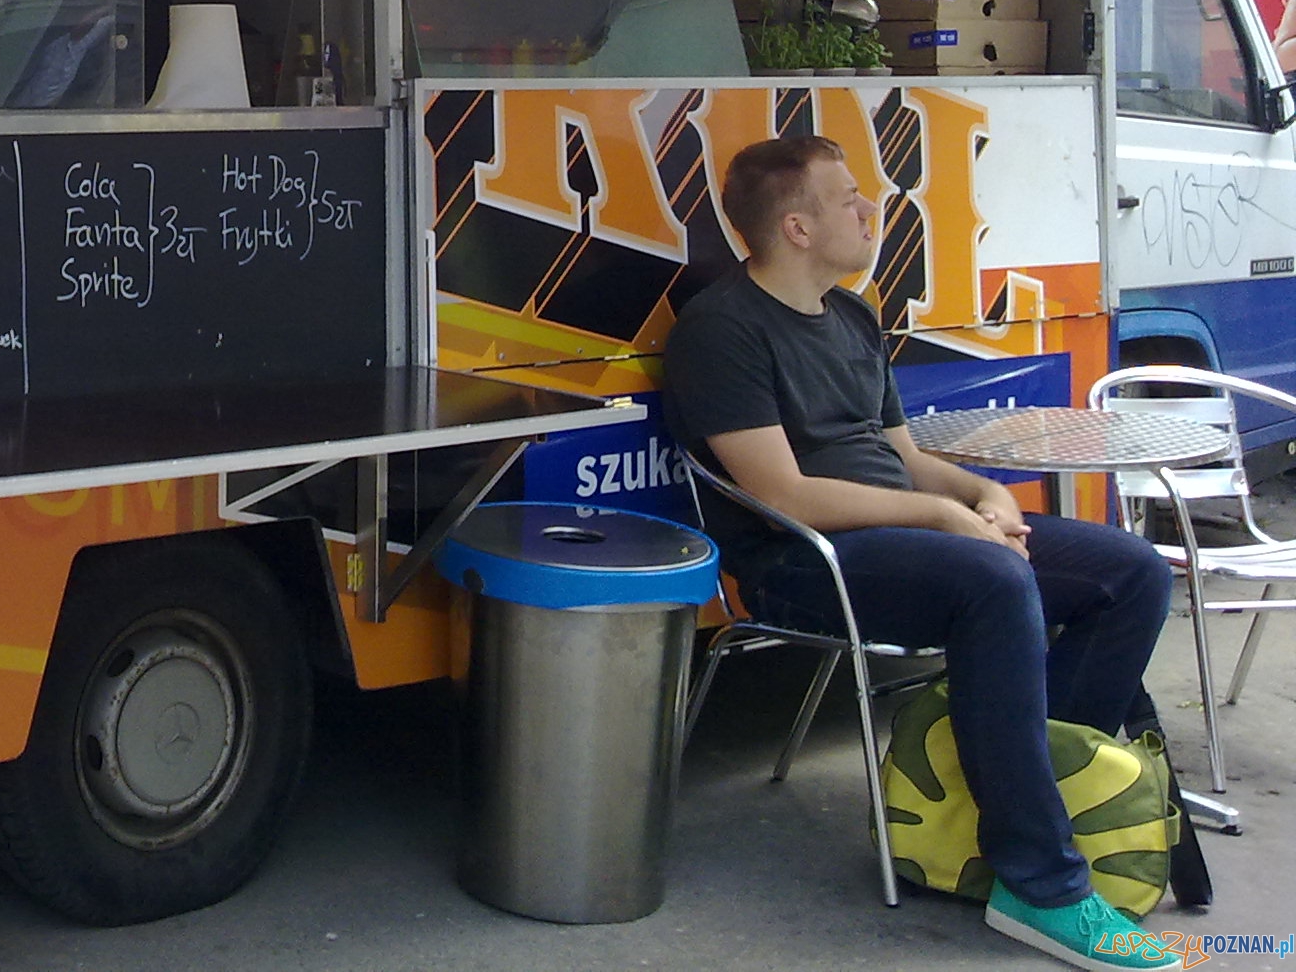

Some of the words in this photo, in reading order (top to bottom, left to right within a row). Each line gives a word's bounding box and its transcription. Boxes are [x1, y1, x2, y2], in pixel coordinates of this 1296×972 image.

[64, 162, 120, 205] Cola
[222, 153, 262, 195] Hot
[268, 161, 306, 208] Dog
[65, 207, 145, 252] Fanta
[218, 207, 294, 266] Frytki
[57, 256, 140, 302] Sprite
[575, 441, 686, 497] szuka
